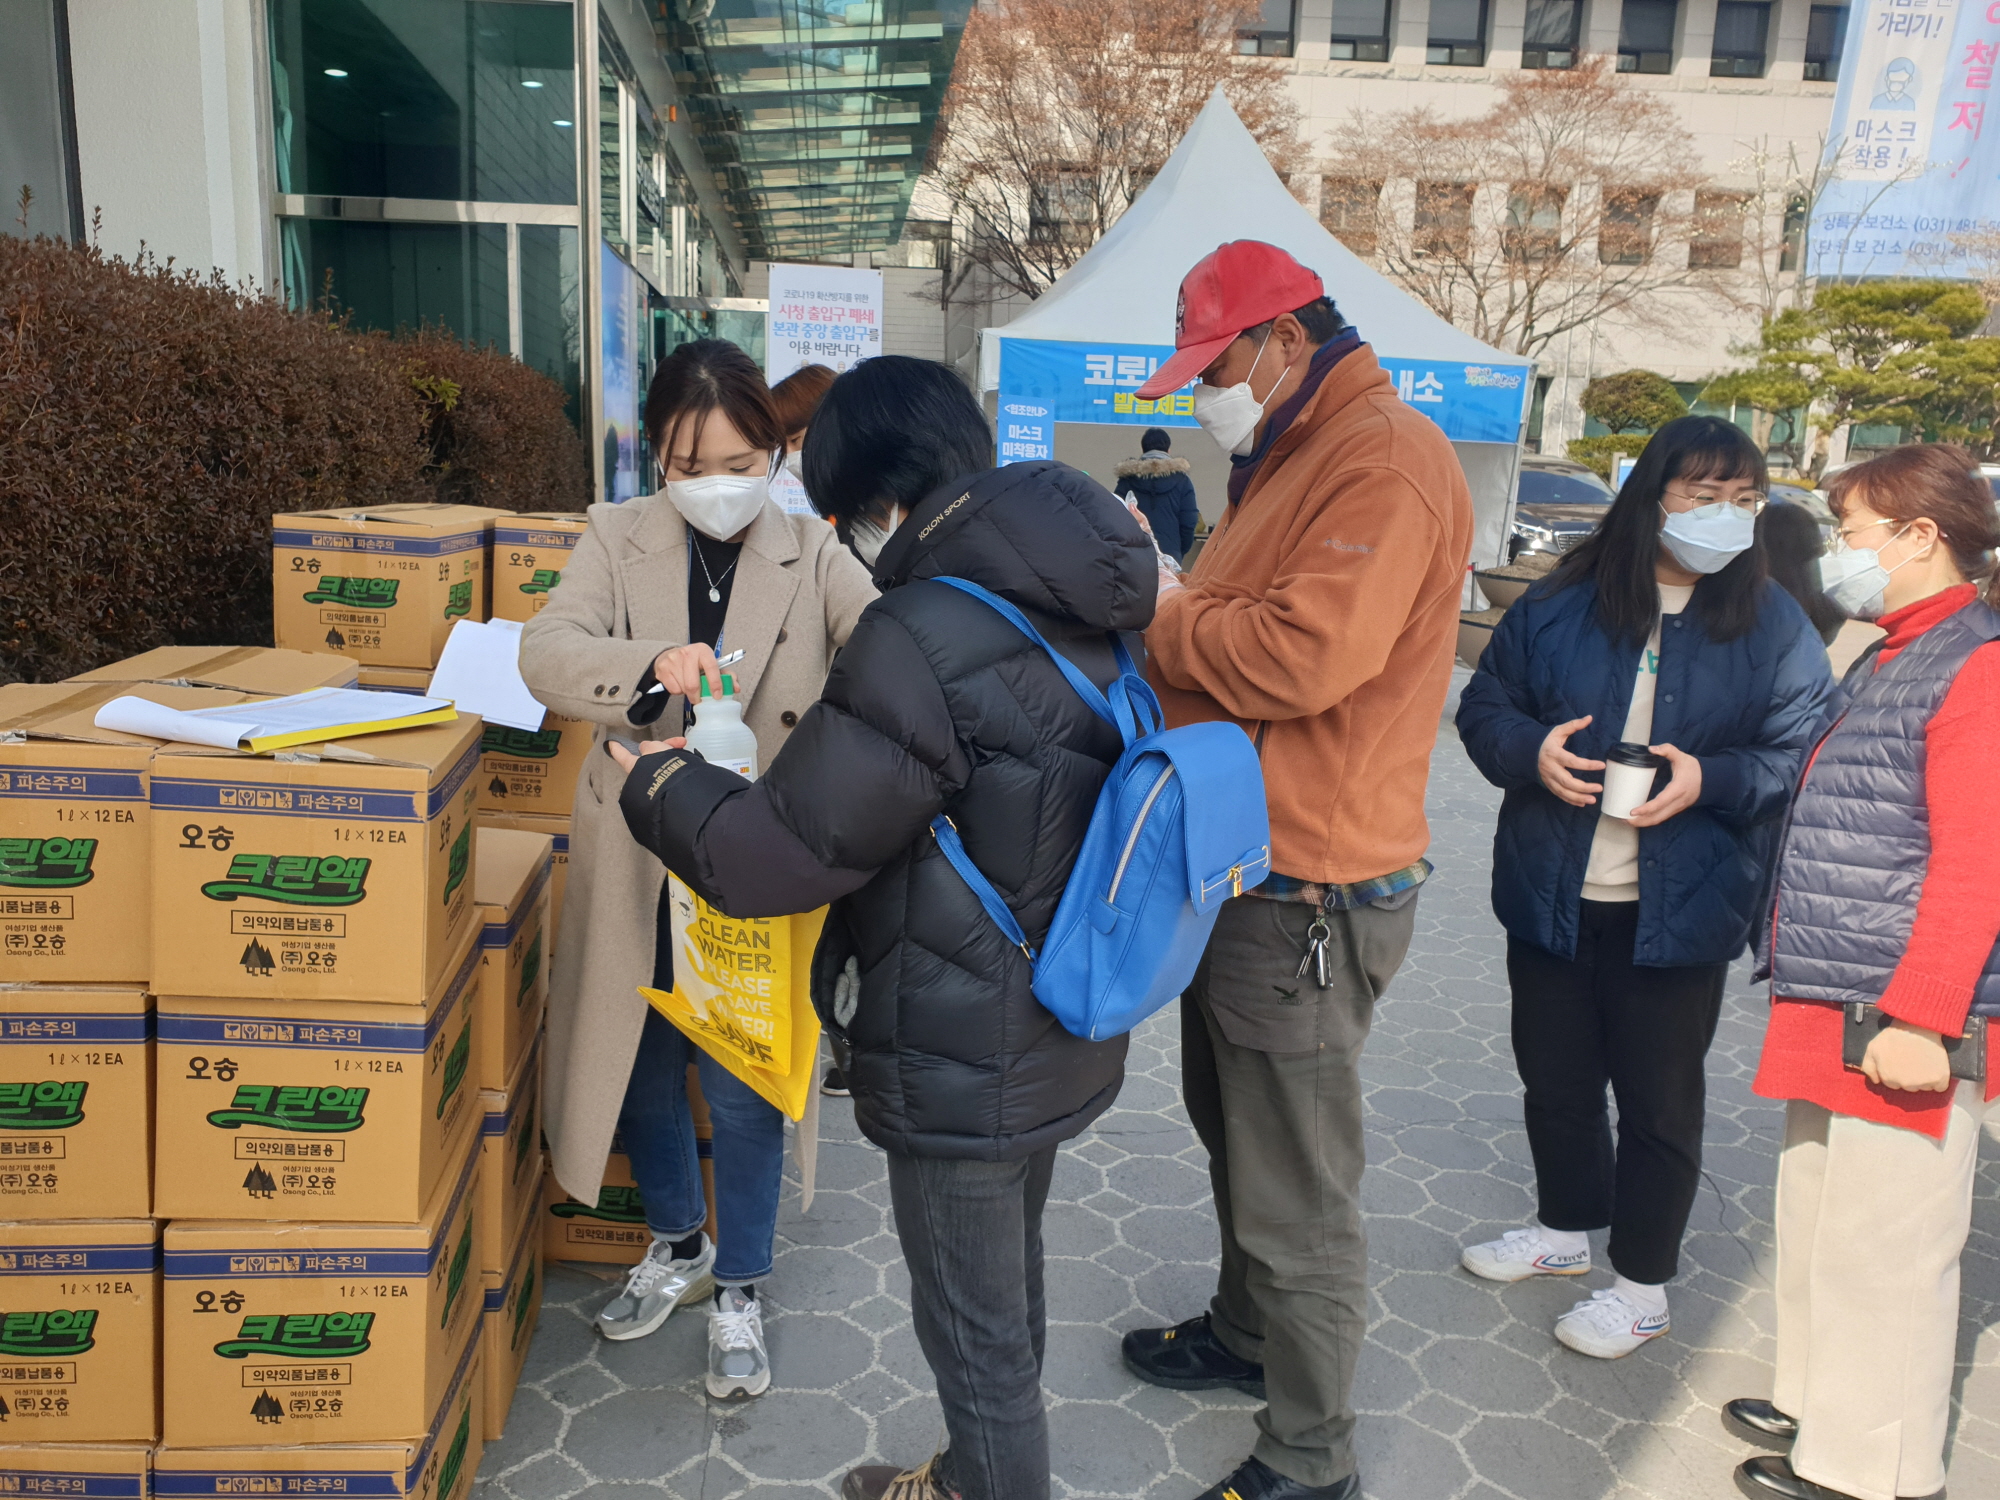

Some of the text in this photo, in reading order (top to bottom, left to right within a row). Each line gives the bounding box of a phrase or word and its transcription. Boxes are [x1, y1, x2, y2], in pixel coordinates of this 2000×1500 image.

[1854, 119, 1917, 143] 마스크
[783, 288, 869, 303] 코로나19 확산방지를 위한
[779, 304, 874, 324] 시청 출입구 폐쇄
[773, 321, 879, 342] 본관 중앙 출입구를
[789, 341, 864, 358] 이용 바랍니다.
[1008, 424, 1043, 441] 마스크
[1002, 442, 1049, 459] 미착용자
[917, 491, 971, 541] KOLON SPORT
[357, 539, 394, 550] 파손주의
[290, 556, 322, 574] 오송
[409, 562, 420, 571] EA
[509, 553, 536, 568] 오송
[303, 576, 400, 608] 크린액
[363, 635, 381, 645] 오송
[17, 775, 87, 792] 파손주의
[298, 793, 363, 812] 파손주의
[94, 809, 110, 822] 12
[115, 810, 135, 823] EA
[179, 824, 235, 851] 오송
[369, 829, 384, 842] 12
[388, 831, 407, 843] EA
[201, 854, 372, 907] 크린액
[242, 915, 334, 932] 의약외품납품용
[699, 917, 770, 949] CLEAN
[4, 934, 66, 949] (주) 오송
[280, 950, 337, 967] (주) 오송
[696, 934, 776, 973] WATER.
[705, 959, 772, 997] PLEASE
[725, 990, 773, 1016] SAVE
[9, 1021, 76, 1036] 파손주의
[299, 1027, 361, 1043] 파손주의
[85, 1053, 100, 1065] 12
[105, 1053, 123, 1065] EA
[368, 1060, 382, 1072] 12
[386, 1061, 403, 1073] EA
[186, 1056, 239, 1082] 오송
[206, 1085, 370, 1133] 크린액
[246, 1142, 334, 1157] 의약외품납품용
[0, 1173, 58, 1188] (주) 오송
[282, 1175, 336, 1190] (주) 오송
[22, 1253, 87, 1268] 파손주의
[305, 1256, 366, 1270] 파손주의
[95, 1283, 110, 1294] 12
[115, 1282, 133, 1293] EA
[373, 1286, 387, 1297] 12
[391, 1286, 408, 1297] EA
[192, 1290, 245, 1313] 오송
[213, 1312, 376, 1358] 크린액
[253, 1368, 341, 1382] 의약외품납품용
[14, 1397, 69, 1411] (주) 오송
[289, 1399, 343, 1412] (주) 오송
[25, 1478, 86, 1493] 파손주의
[287, 1478, 347, 1492] 파손주의
